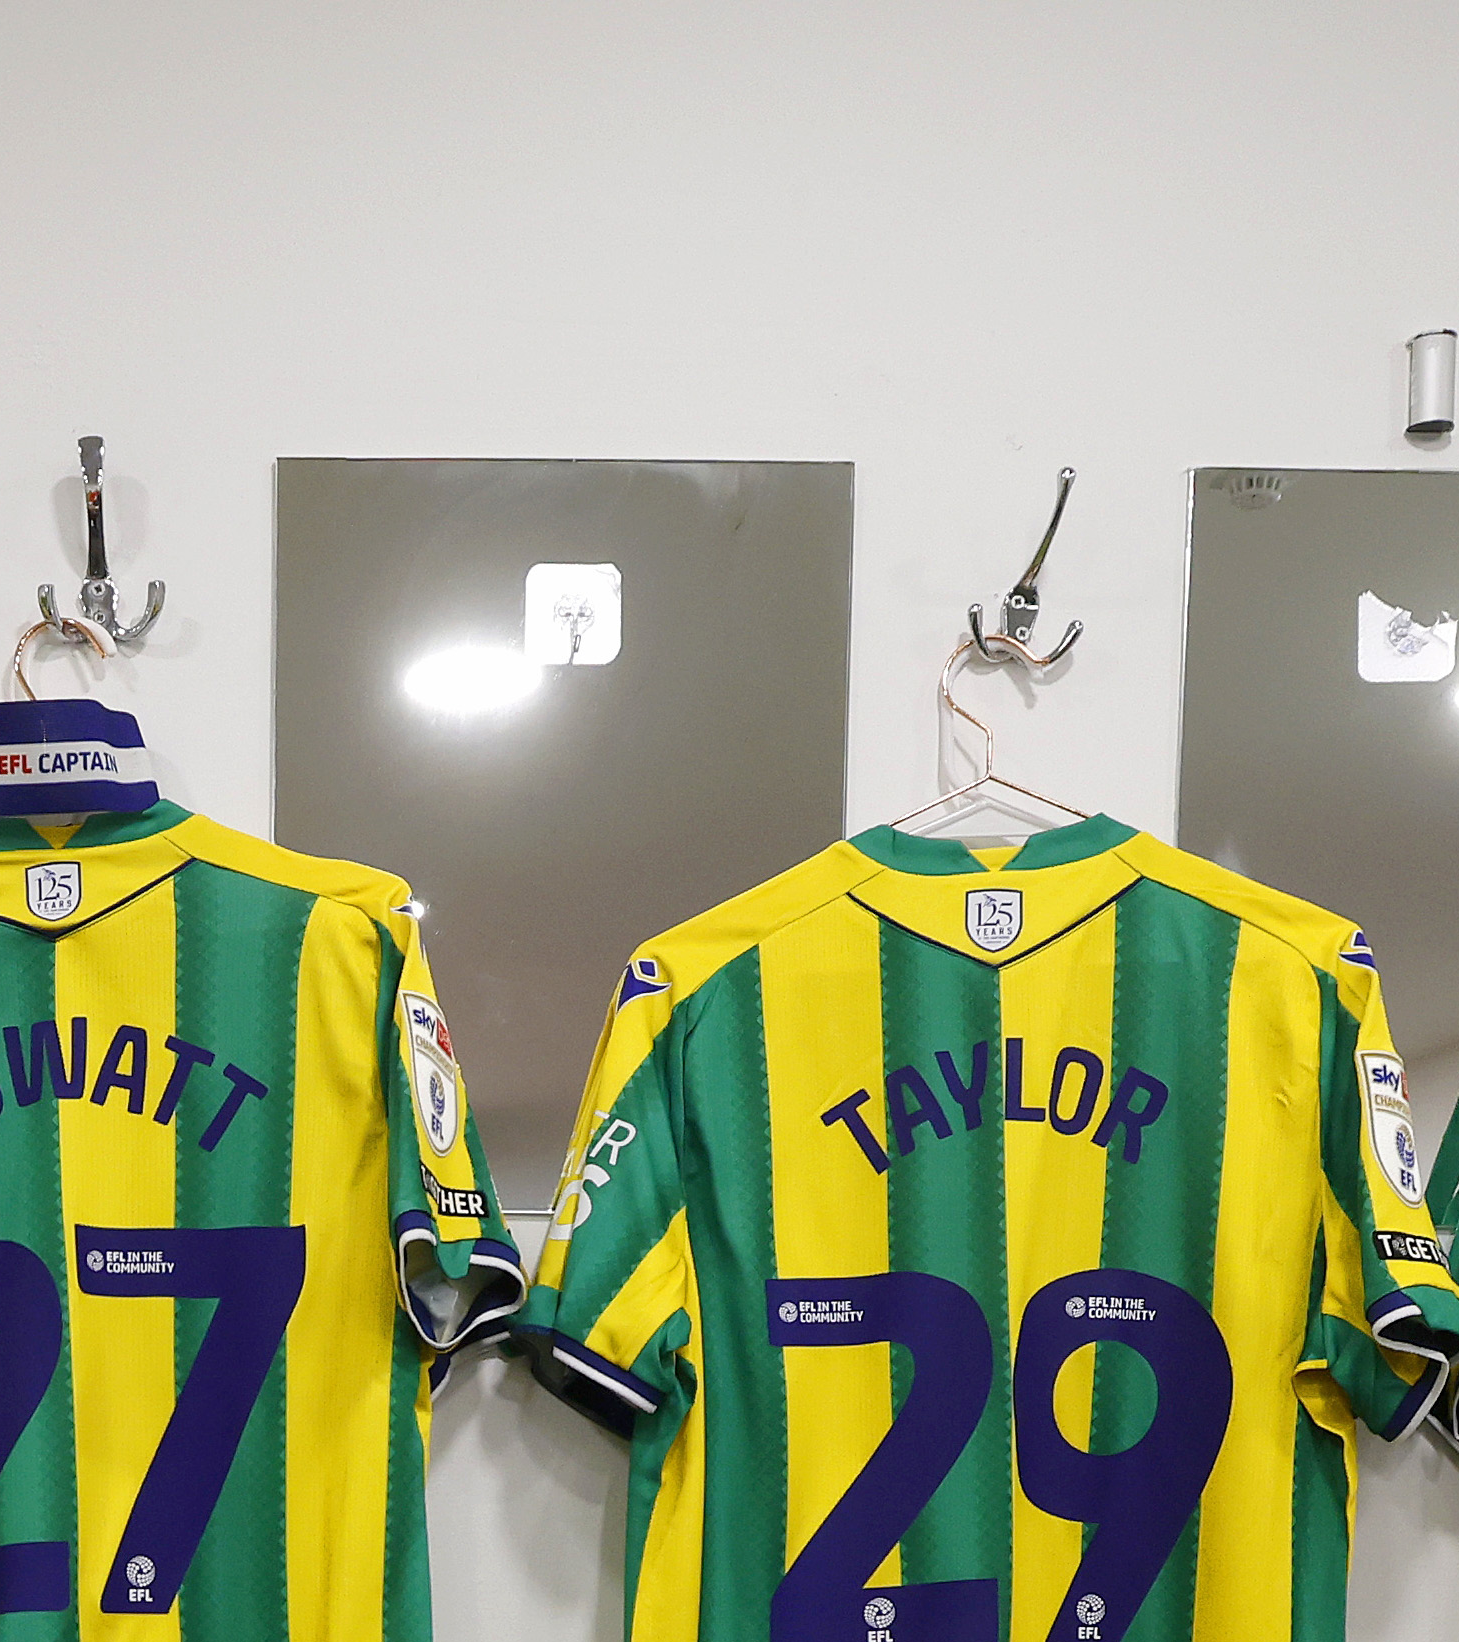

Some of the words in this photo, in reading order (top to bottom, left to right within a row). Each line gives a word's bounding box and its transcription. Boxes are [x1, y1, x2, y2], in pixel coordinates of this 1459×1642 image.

[38, 751, 119, 774] CAPTAIN
[34, 873, 72, 902] 125
[36, 900, 72, 911] YEARS
[974, 902, 1014, 927] 125
[975, 926, 1013, 936] YEARS
[413, 1007, 436, 1038] sky
[1372, 1064, 1401, 1092] sky
[819, 1037, 1170, 1176] TAYLOR
[431, 1112, 444, 1141] EFL
[1401, 1167, 1417, 1193] EFL
[106, 1251, 127, 1262] EFL
[127, 1251, 141, 1262] IN
[142, 1251, 163, 1262] THE
[106, 1262, 175, 1273] COMMUNITY
[799, 1301, 817, 1312] EFL
[817, 1301, 830, 1312] IN
[831, 1300, 851, 1311] THE
[1088, 1296, 1109, 1308] EFL
[1109, 1297, 1123, 1308] IN
[1124, 1298, 1145, 1310] THE
[800, 1310, 864, 1323] COMMUNITY
[1088, 1307, 1156, 1321] COMMUNITY
[128, 1588, 153, 1602] EFL
[1078, 1626, 1101, 1640] EFL
